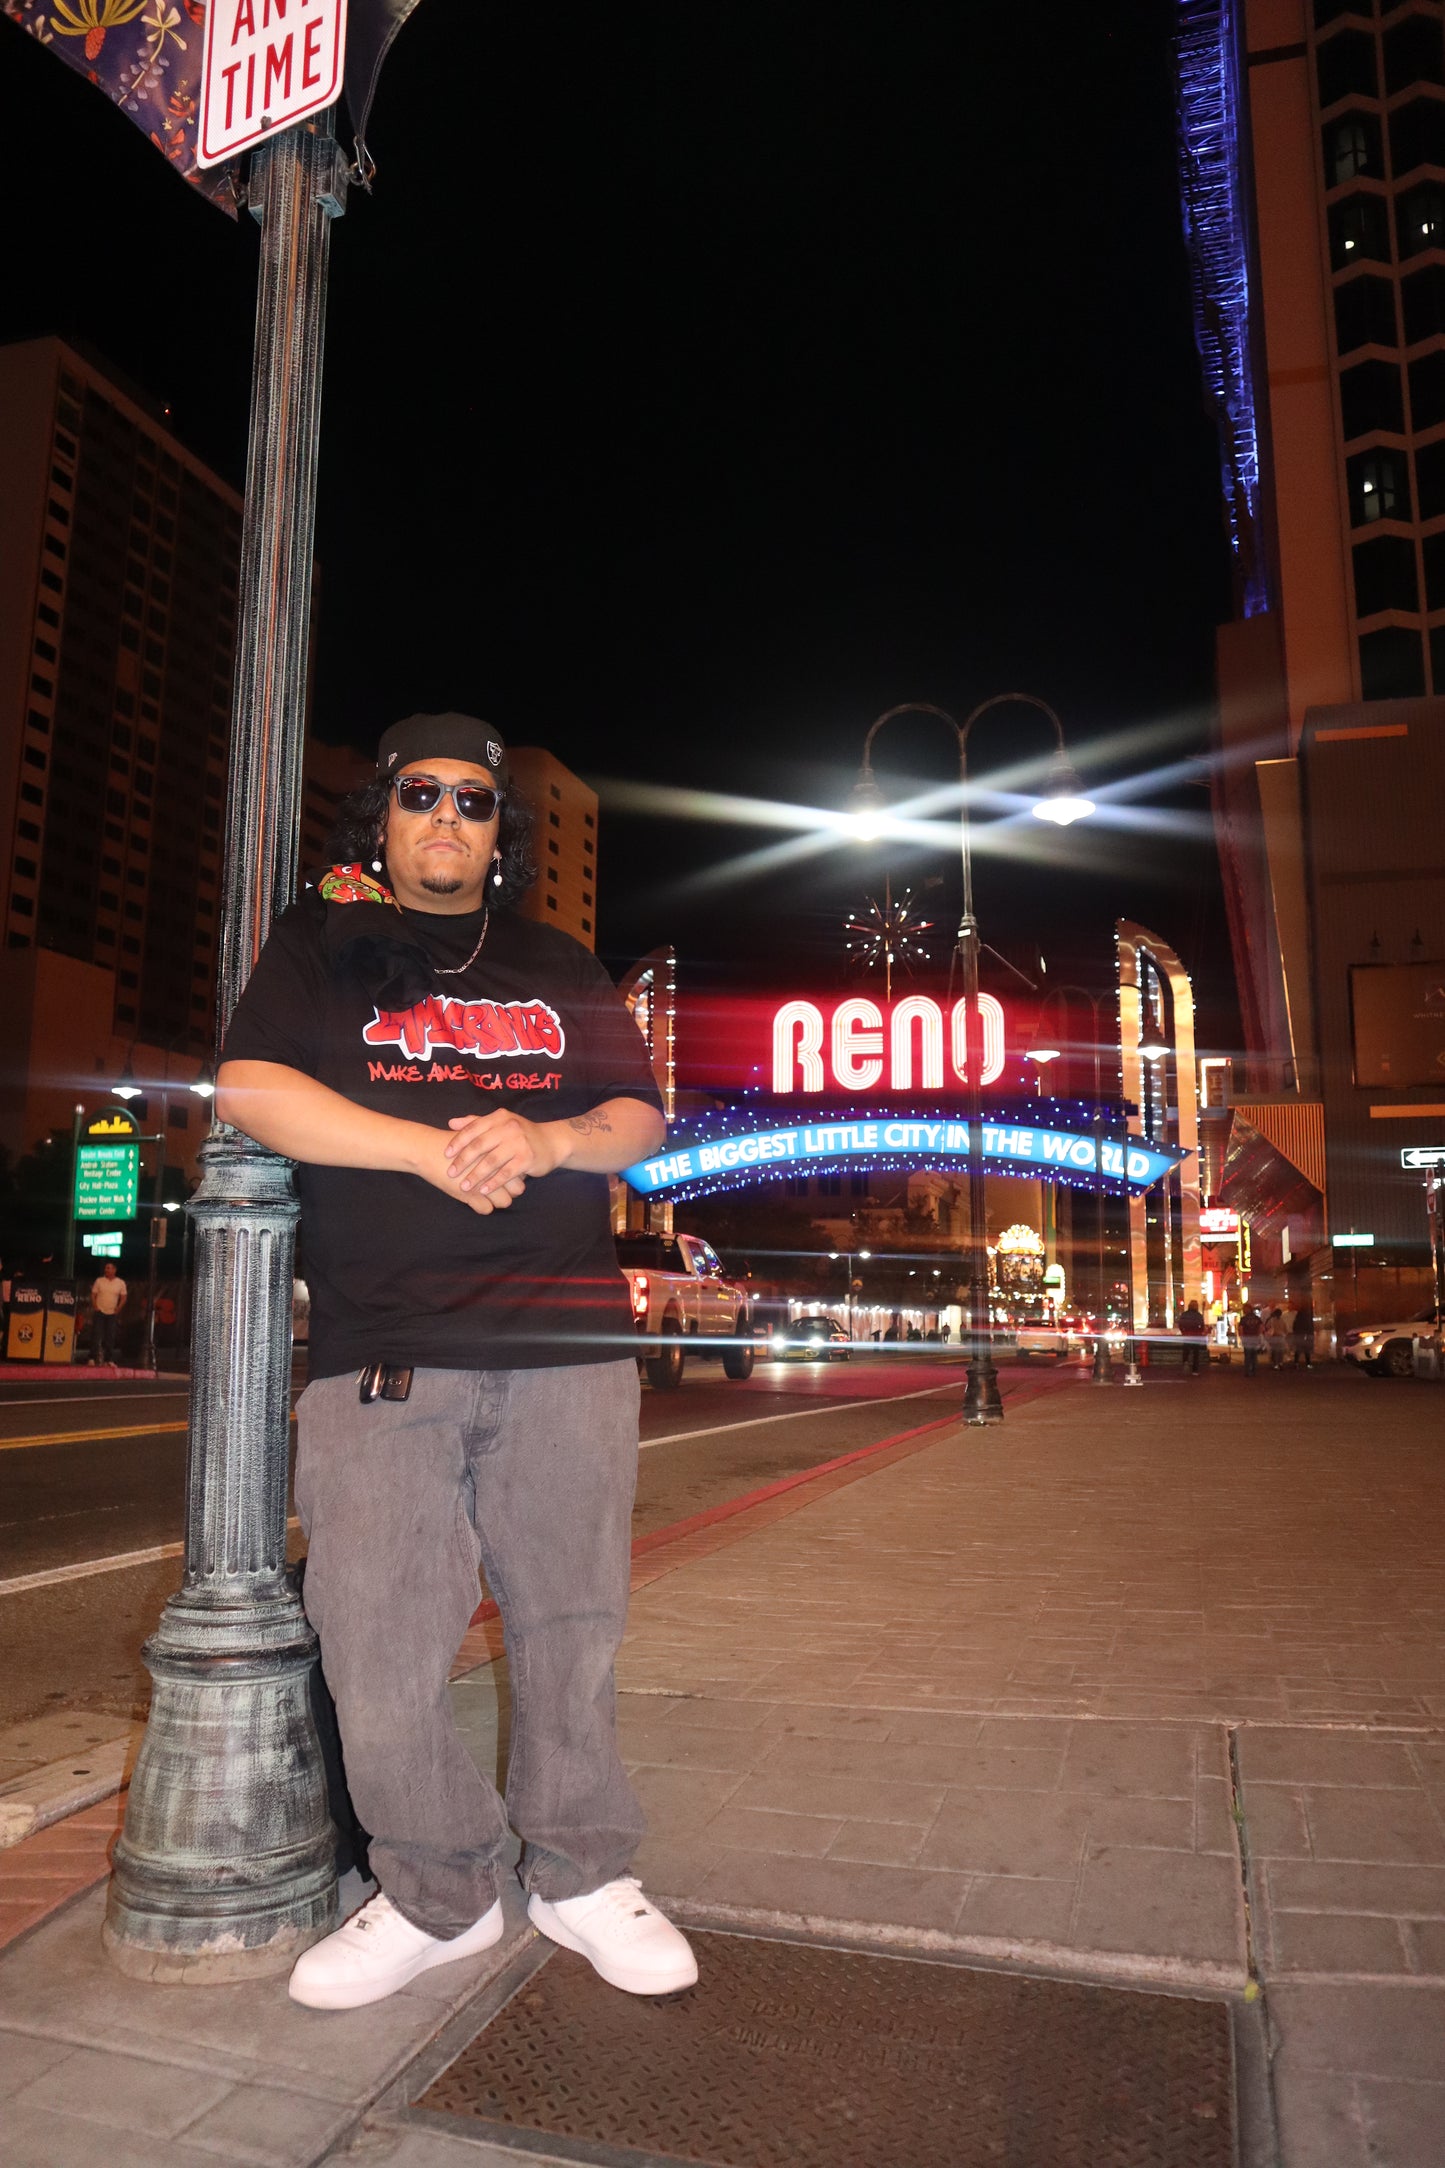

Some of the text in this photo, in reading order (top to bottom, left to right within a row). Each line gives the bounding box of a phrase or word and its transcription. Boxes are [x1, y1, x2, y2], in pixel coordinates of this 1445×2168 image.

[222, 16, 323, 131] TIME
[367, 1061, 562, 1090] MAKE AMEICA GREAT
[773, 992, 1005, 1093] RENO
[645, 1153, 692, 1185] THE
[699, 1132, 798, 1171] BIGGEST
[804, 1124, 878, 1152] LITTLE
[884, 1123, 936, 1147] CITY
[983, 1128, 1033, 1156] THE
[1042, 1134, 1150, 1178] WORLD
